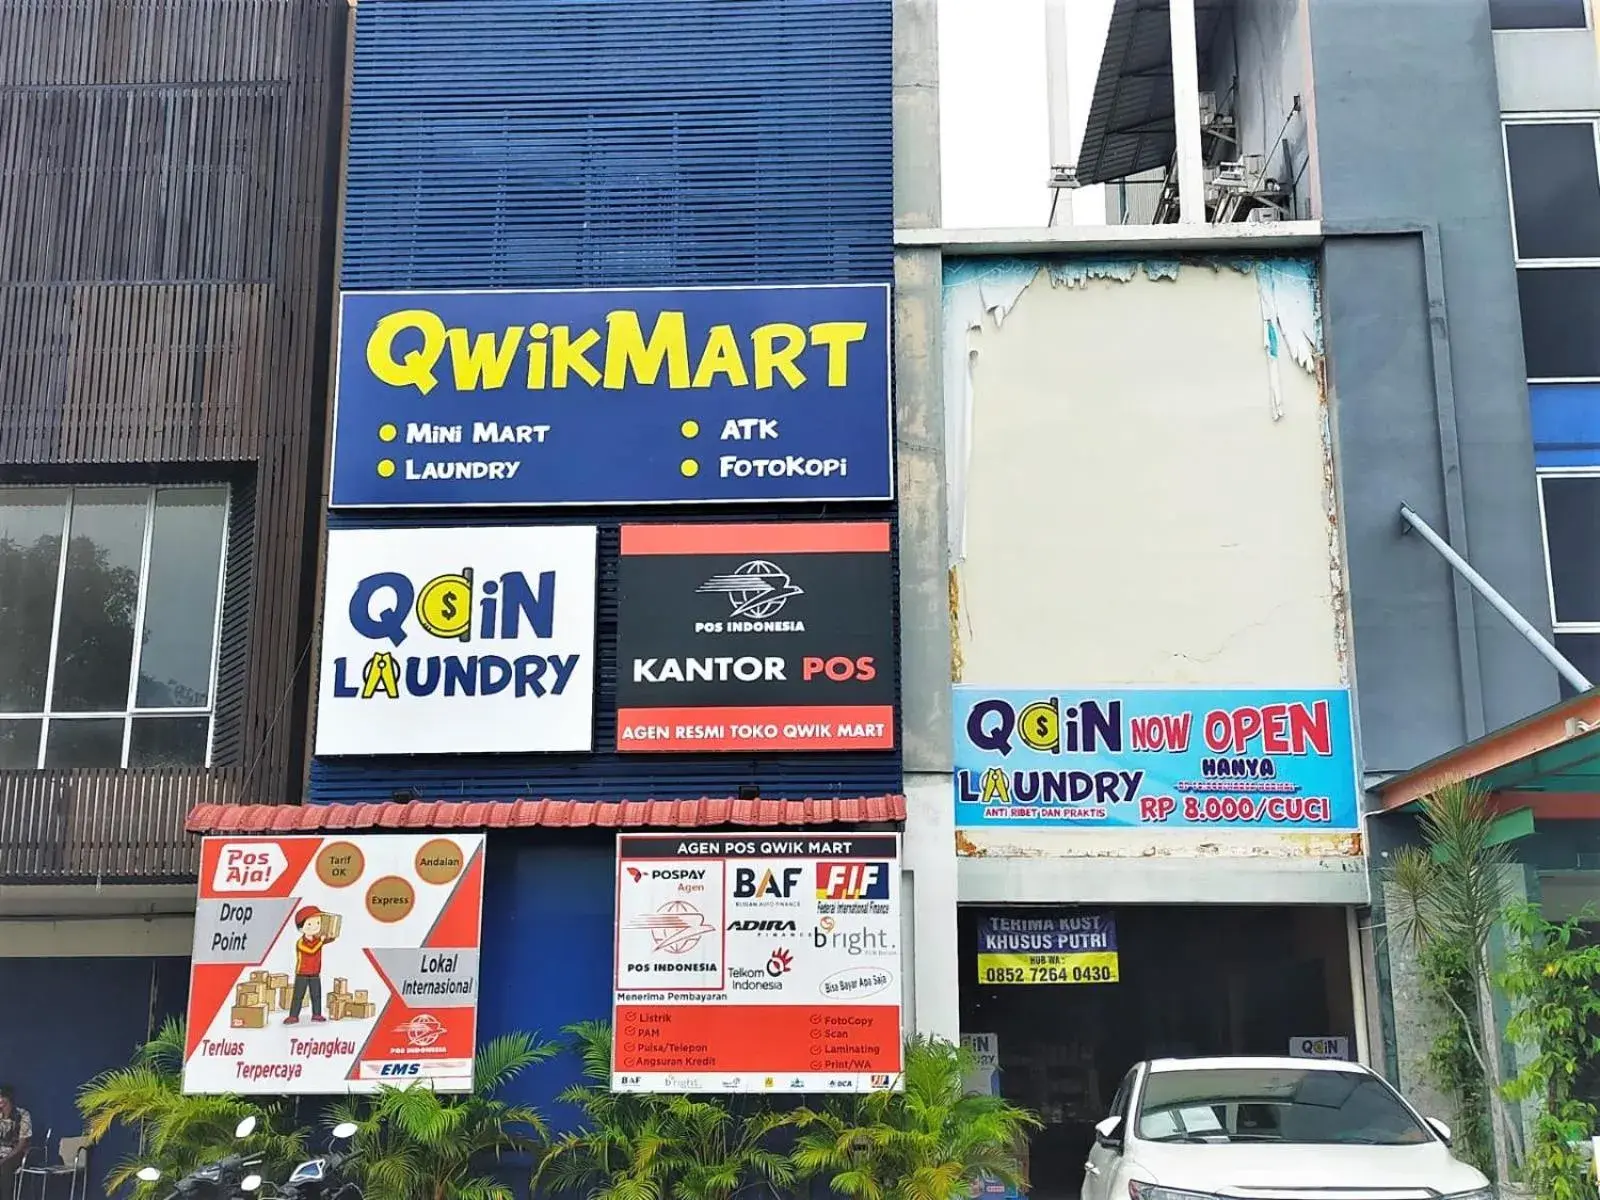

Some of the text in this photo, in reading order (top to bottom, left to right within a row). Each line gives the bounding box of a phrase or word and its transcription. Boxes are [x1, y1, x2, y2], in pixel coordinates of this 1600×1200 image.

[473, 422, 550, 443] MART
[720, 418, 778, 440] ATK
[405, 459, 520, 480] LAUNDRY
[695, 621, 805, 633] POS INDONESIA
[334, 652, 580, 698] LAUNDRY
[633, 656, 876, 682] KANTOR POS
[622, 723, 885, 740] AGEN RESMI TOKO QWIK MART
[1131, 713, 1194, 752] NOW
[1205, 702, 1331, 755] OPEN
[1202, 758, 1275, 776] HANYA
[958, 768, 1144, 804] LAUNDRY
[984, 808, 1106, 818] ANTI RIBET DAN PRAKTIS
[1140, 797, 1330, 822] RP 8.000/CUCI
[677, 842, 852, 854] AGEN POS QWIK MART
[228, 850, 269, 865] Pos
[330, 855, 352, 865] Tarif
[420, 857, 459, 867] Andalan
[226, 866, 271, 885] Aja!
[332, 868, 347, 877] OK
[652, 870, 706, 879] POSPAY
[733, 868, 802, 898] BAF
[827, 865, 879, 896] FIF
[678, 883, 704, 893] Agen
[371, 895, 409, 906] Express
[220, 903, 253, 924] Drop
[727, 920, 796, 931] ADIRA
[212, 933, 247, 951] Point
[986, 933, 1107, 949] KHUSUS PUTRI
[421, 954, 457, 973] Lokal
[628, 963, 718, 972] POS INDONESIA
[729, 967, 765, 978] Telkom
[987, 966, 1110, 982] 0852 7264 0430
[402, 978, 473, 995] Internasional
[732, 980, 782, 990] Indonesia
[617, 992, 728, 1003] Menerima Pembayaran
[640, 1013, 672, 1022] Listrik
[824, 1016, 873, 1027] FotoCopy
[638, 1029, 660, 1037] PAM
[825, 1029, 848, 1038] Scan
[202, 1038, 355, 1058] Terluas Terjangkau
[638, 1044, 708, 1053] Pulsa/Telepon
[825, 1044, 880, 1055] Laminating
[636, 1056, 716, 1067] Angsuran Kredit
[825, 1060, 871, 1069] Print/WA
[236, 1062, 302, 1081] Terpercaya
[381, 1064, 420, 1075] EMS
